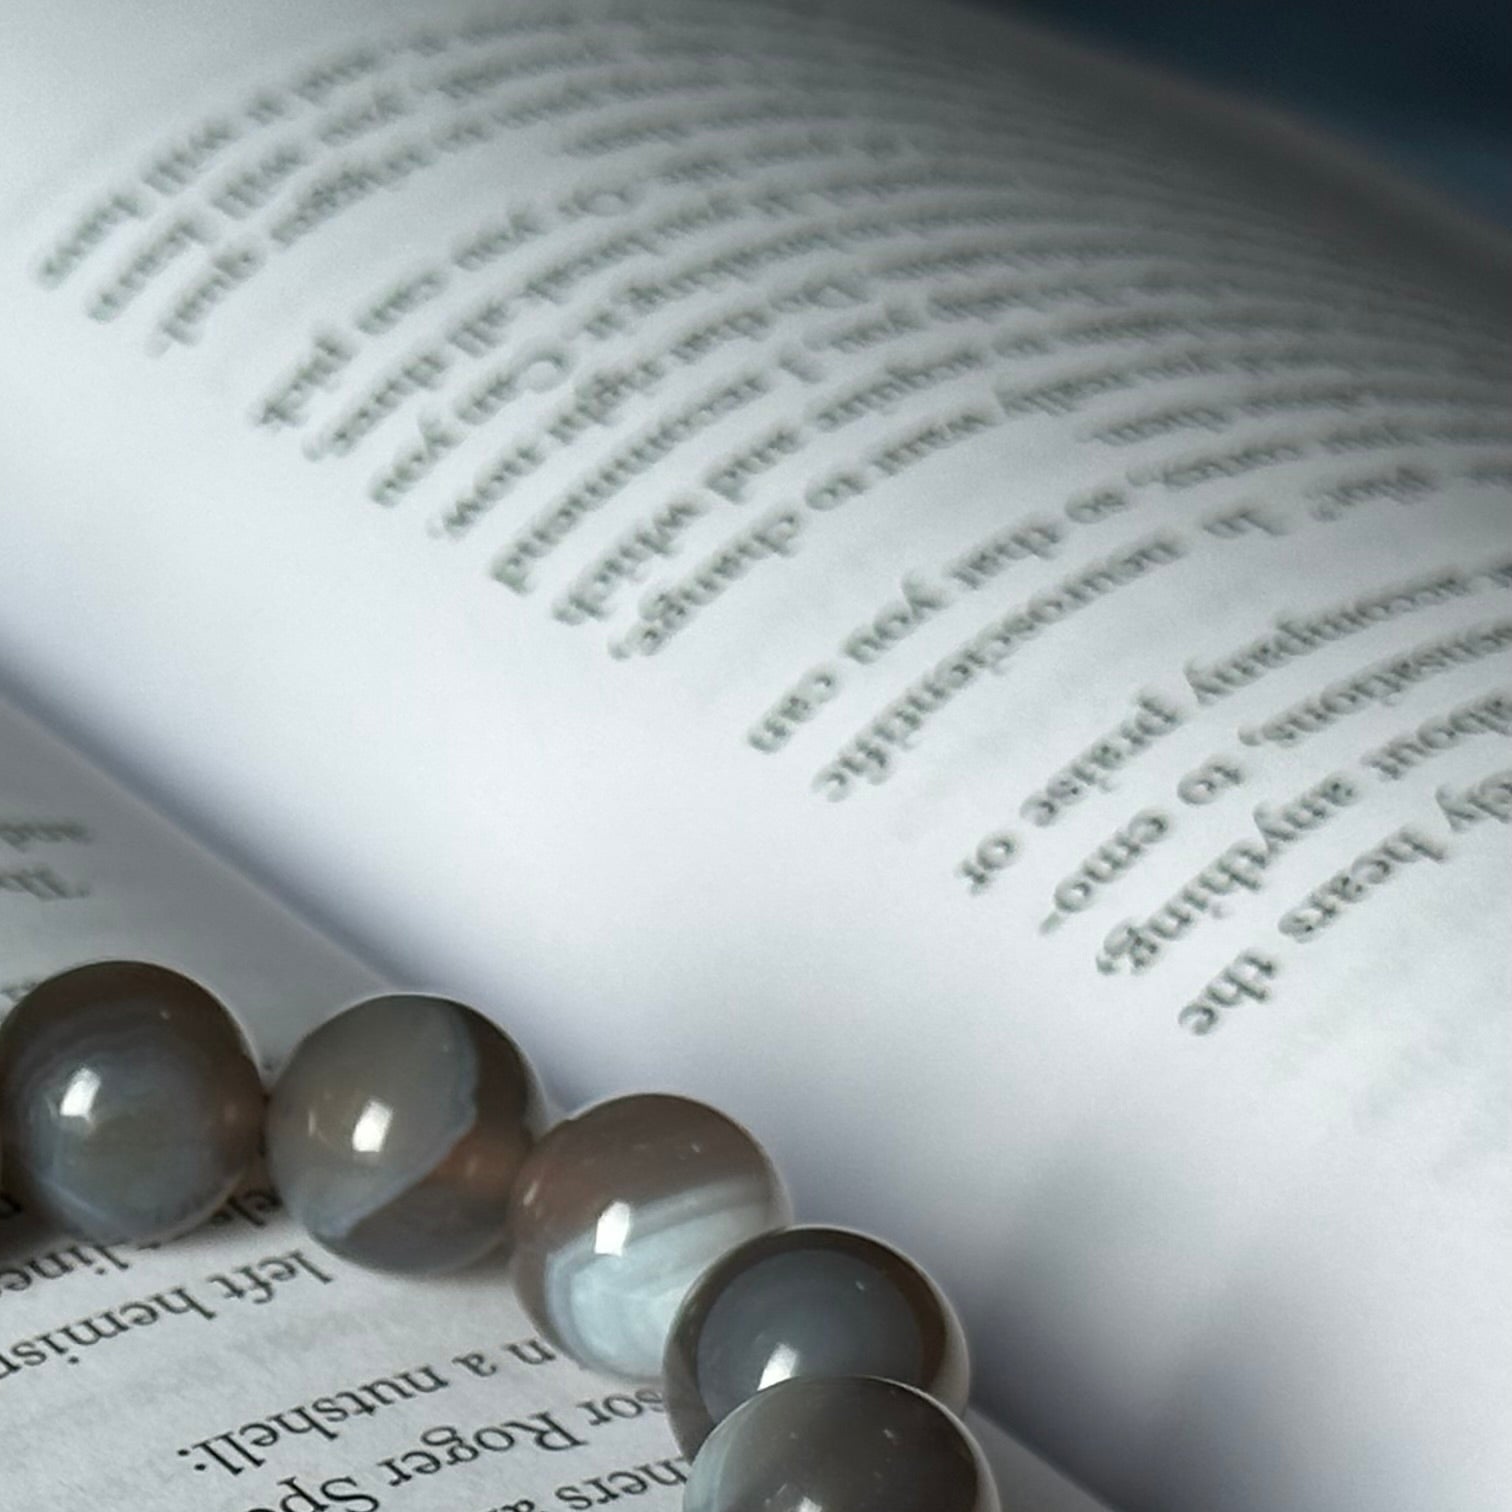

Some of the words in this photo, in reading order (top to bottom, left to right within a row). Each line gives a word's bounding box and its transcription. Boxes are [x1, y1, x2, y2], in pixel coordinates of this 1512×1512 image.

[208, 1251, 333, 1304] left
[452, 1354, 498, 1377] a
[177, 1366, 449, 1476] nutshell:
[377, 1412, 588, 1487] Roger
